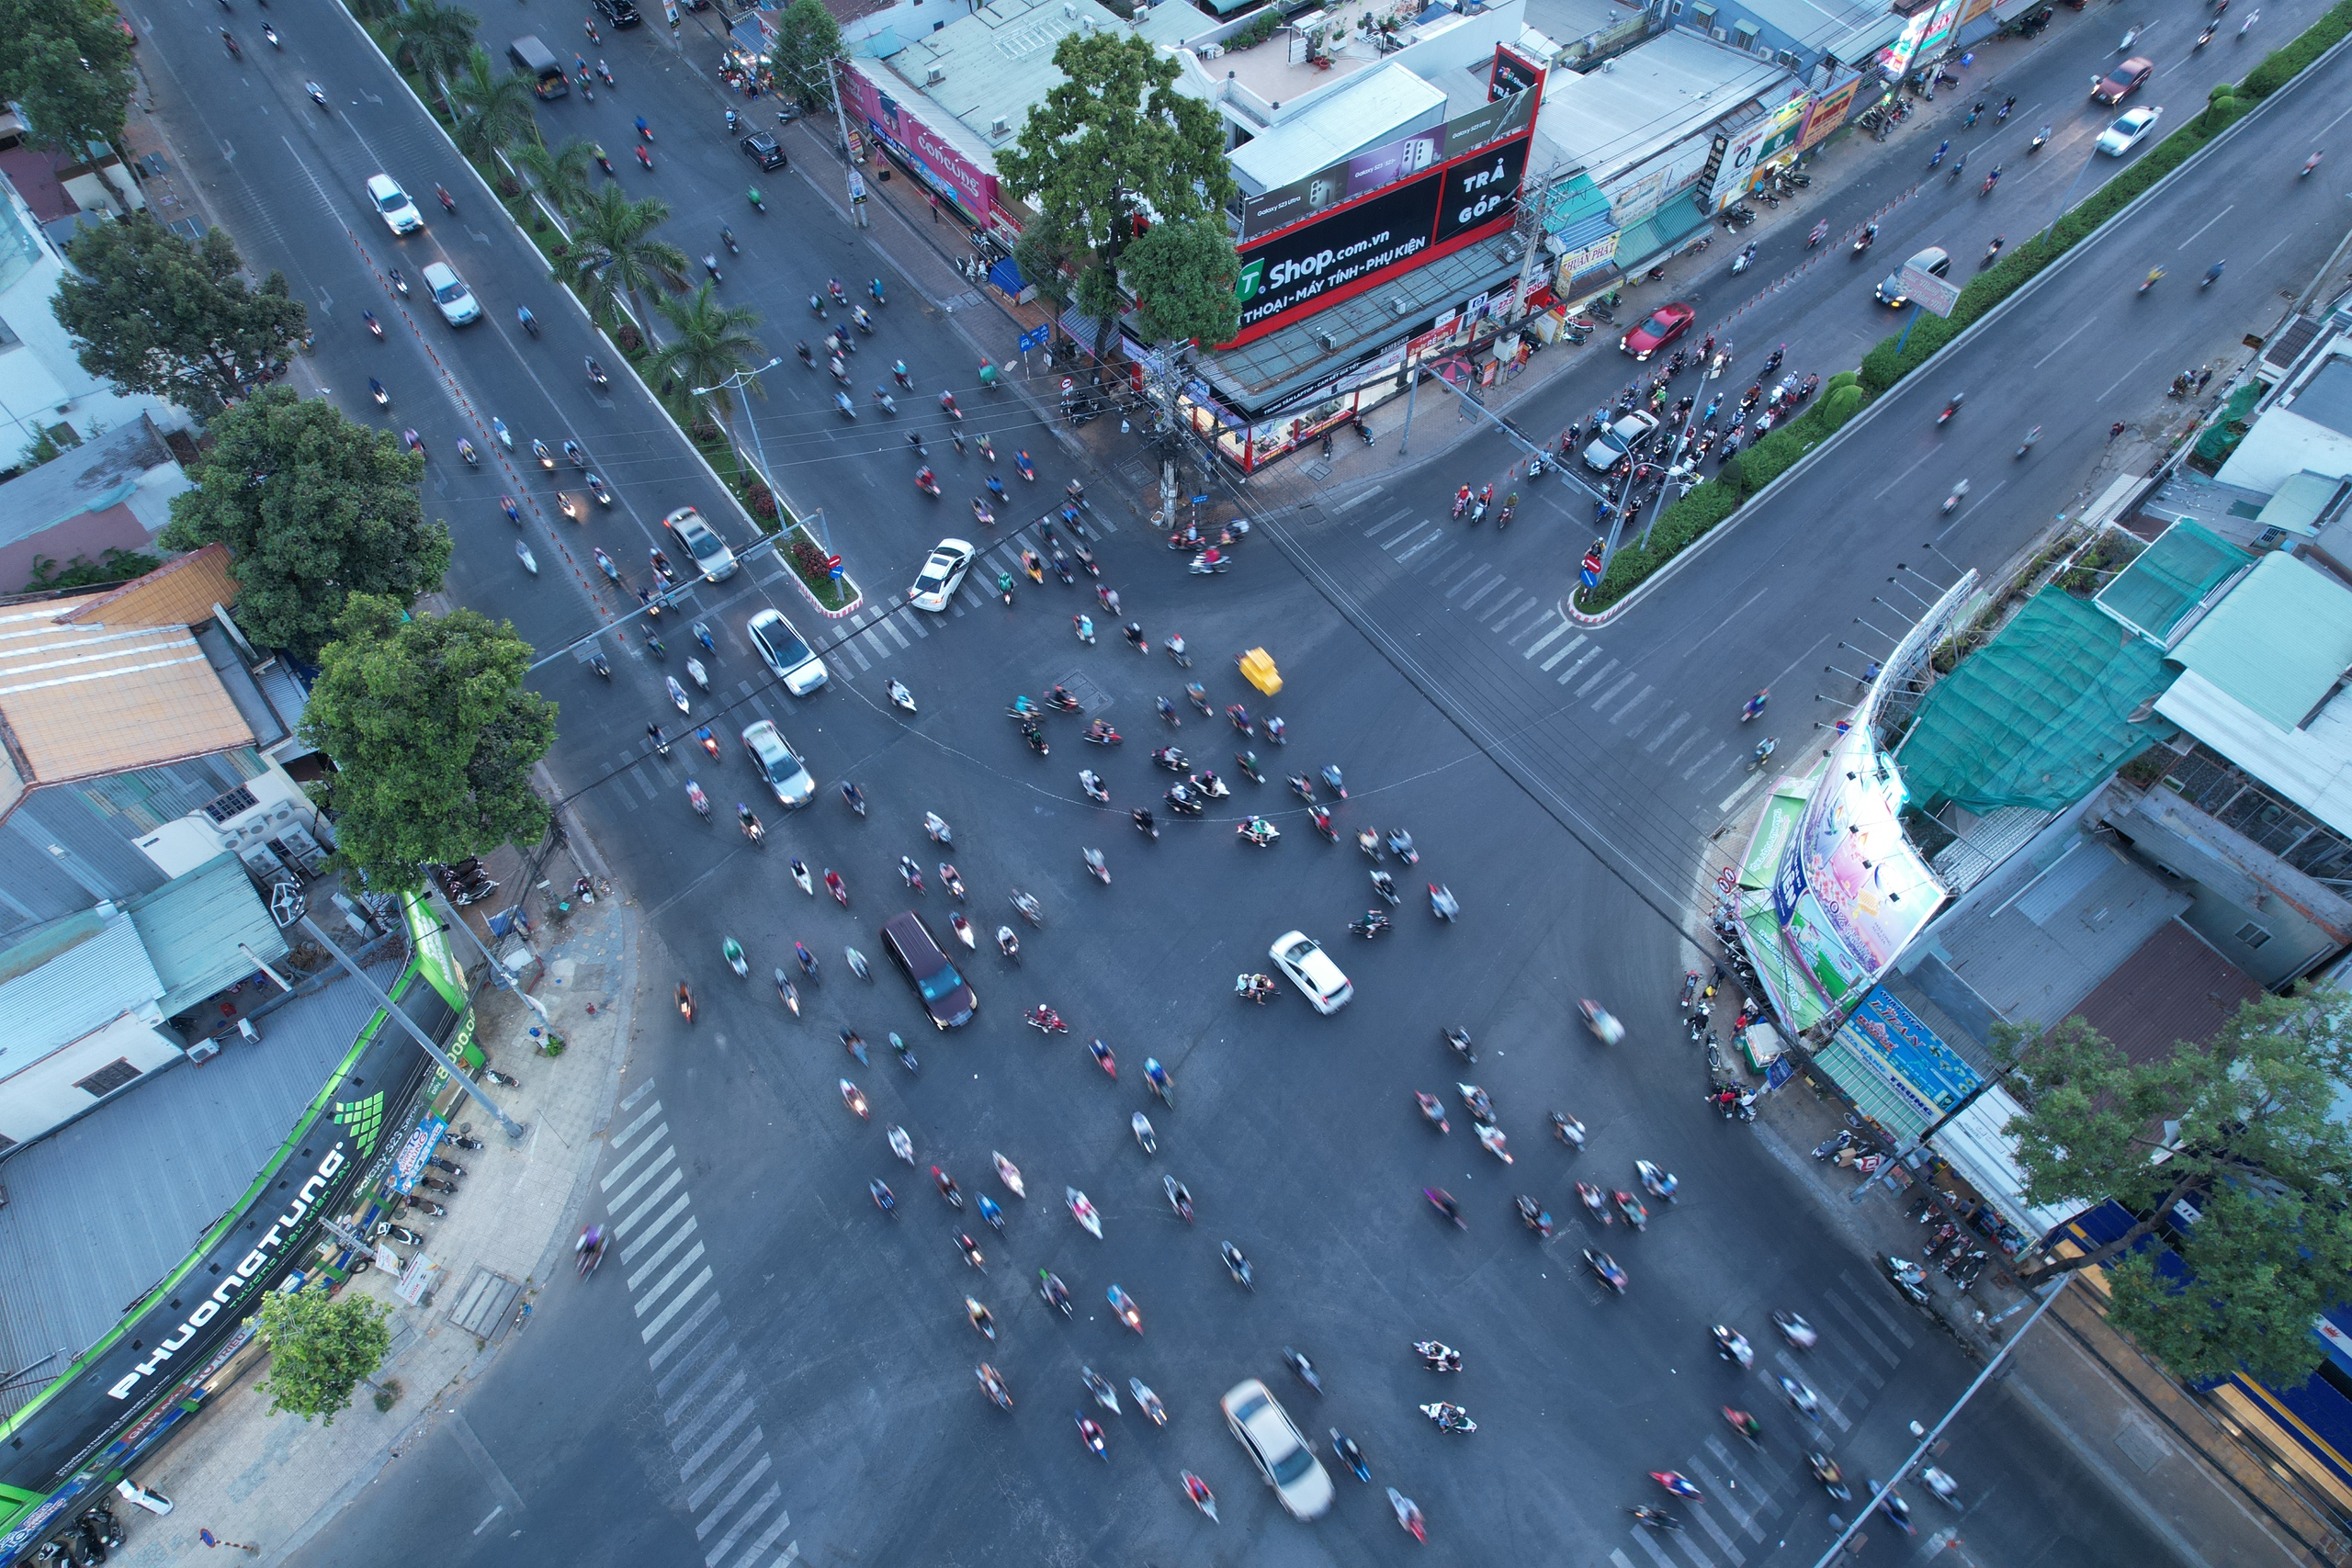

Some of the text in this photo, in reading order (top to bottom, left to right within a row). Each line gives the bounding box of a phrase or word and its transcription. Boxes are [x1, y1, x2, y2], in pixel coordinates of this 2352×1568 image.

[1452, 128, 1470, 139] Galaxy
[1354, 166, 1374, 178] Galaxy
[1374, 163, 1384, 171] S23
[1464, 157, 1505, 193] TRẢ
[1257, 196, 1301, 217] Galaxy S23 Ultra
[1459, 195, 1501, 223] GÓP
[1394, 236, 1426, 259] KIỆN
[1380, 335, 1409, 355] SAMSUNG
[1263, 401, 1282, 415] TRUNG
[1294, 385, 1314, 400] LAPTOP
[1889, 1074, 1935, 1117] TRUNG
